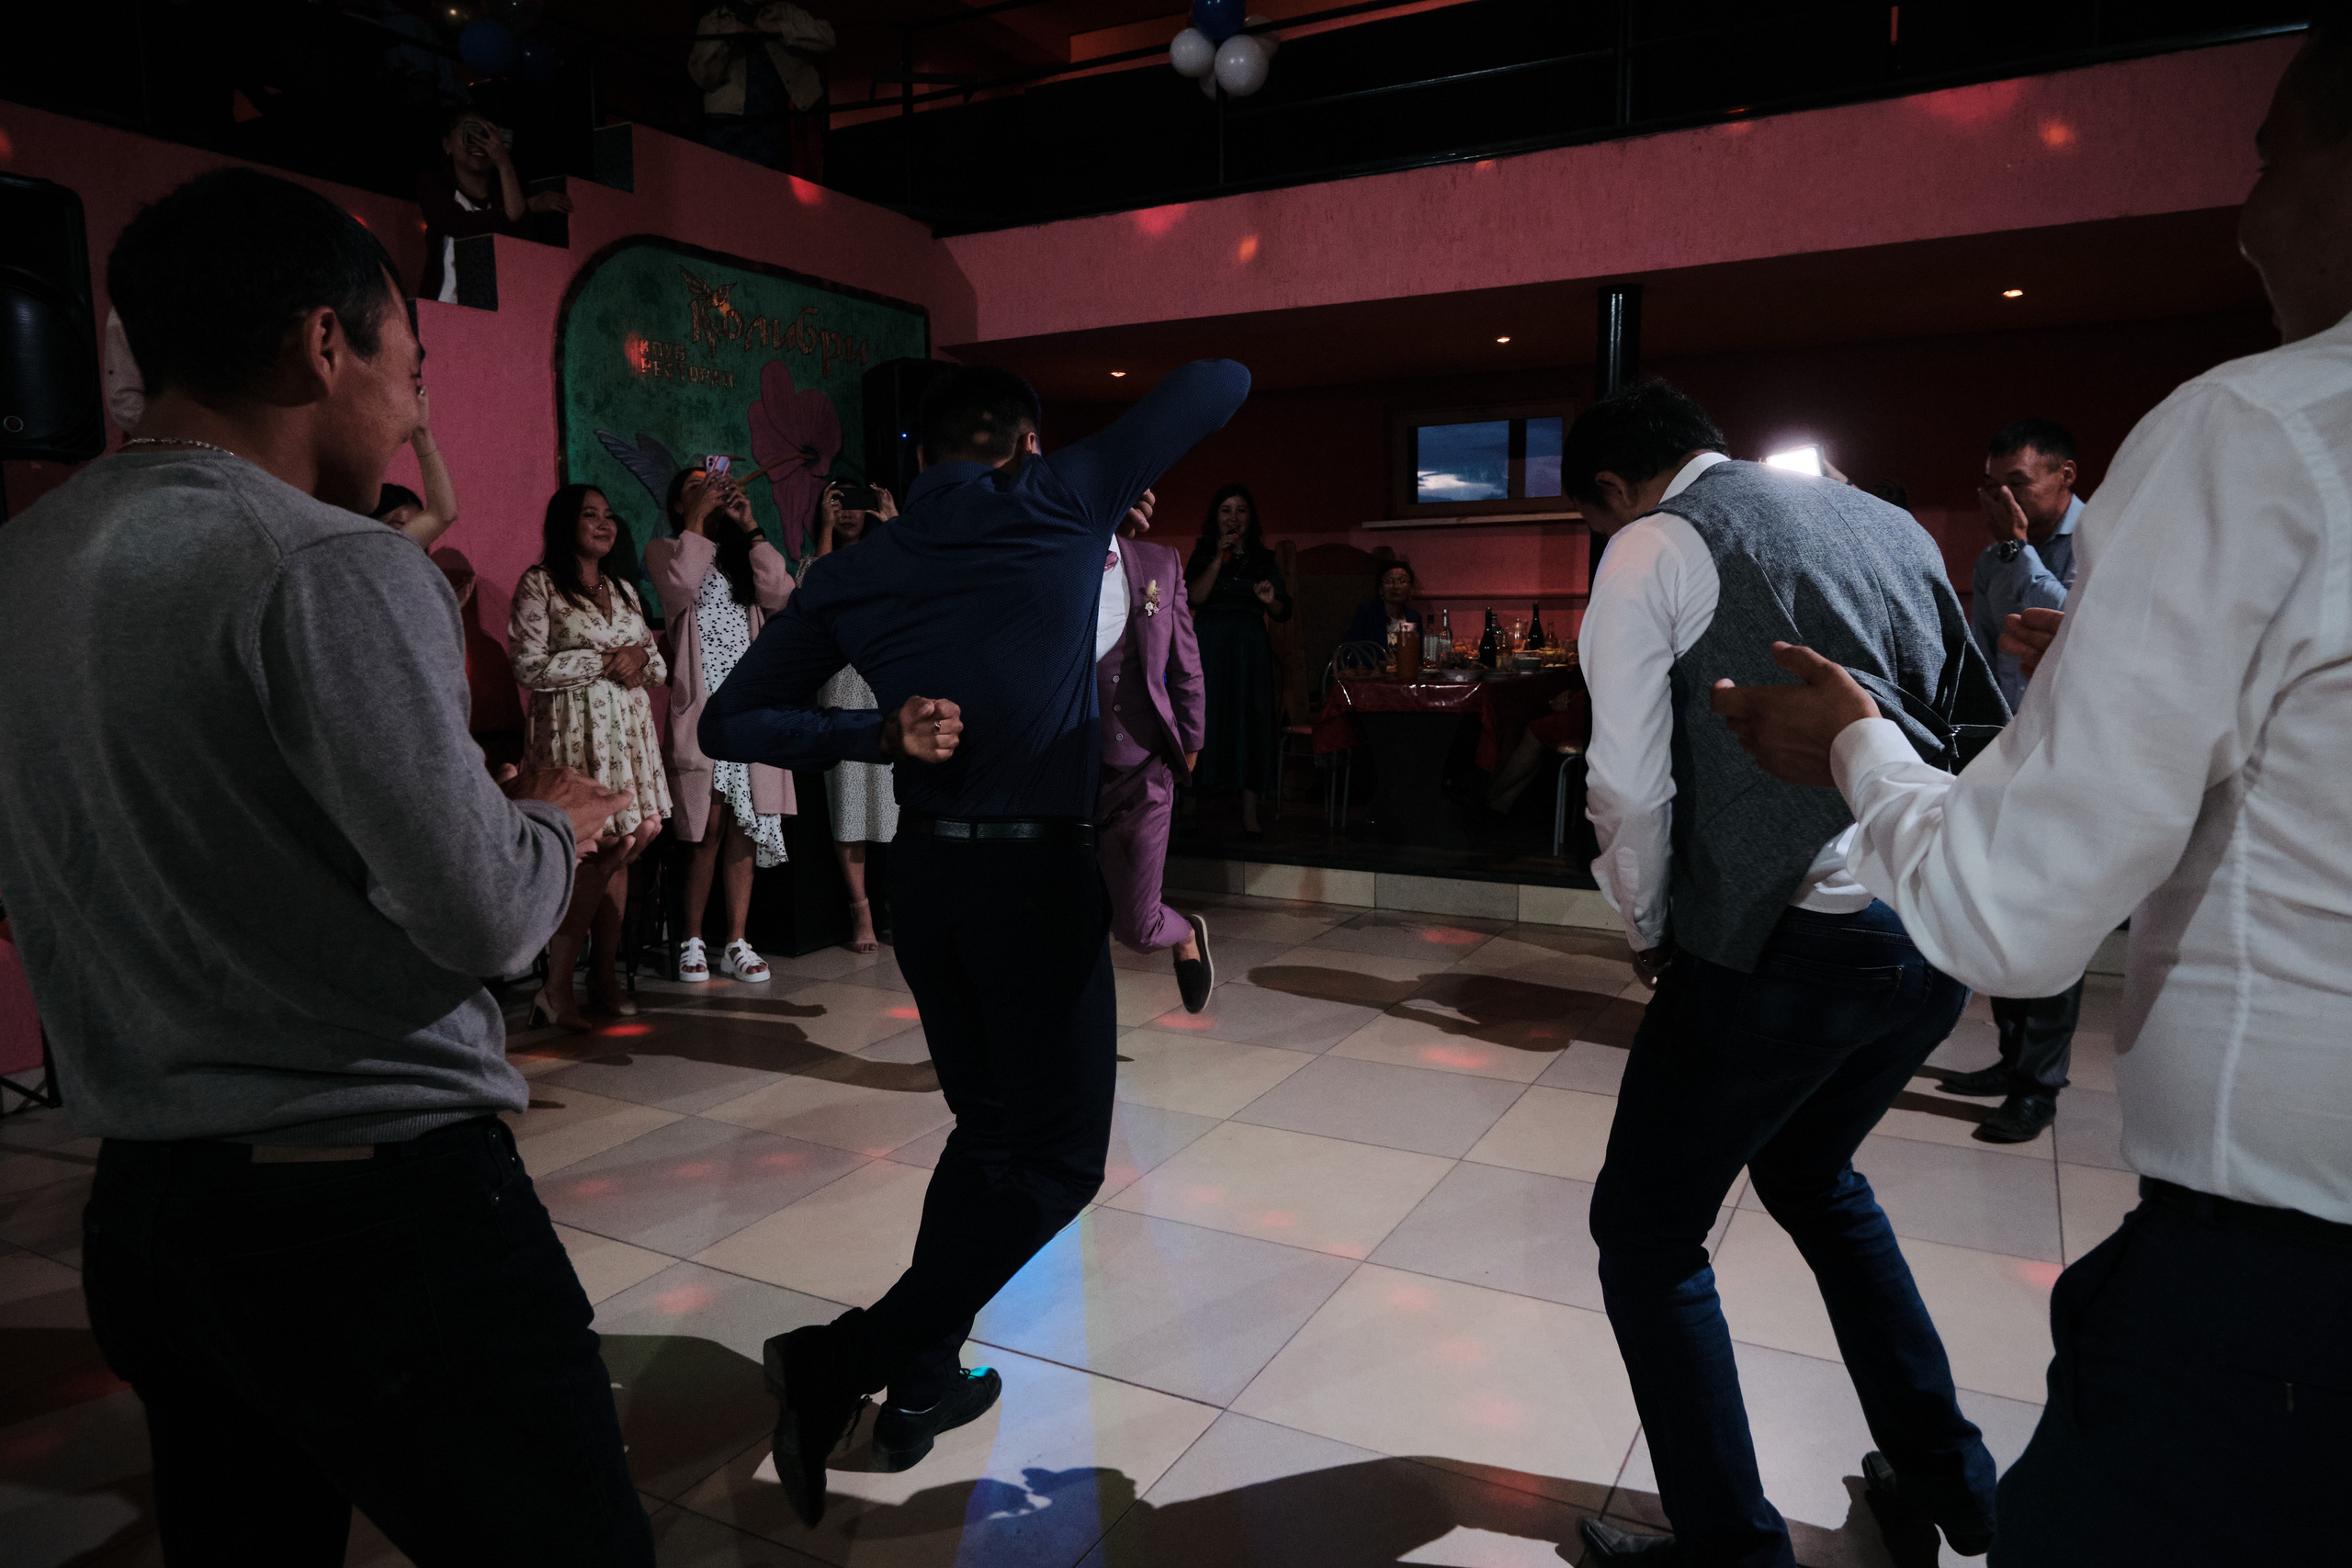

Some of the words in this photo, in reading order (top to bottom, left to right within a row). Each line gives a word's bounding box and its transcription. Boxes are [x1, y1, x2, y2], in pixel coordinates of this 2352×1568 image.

[639, 338, 686, 362] КЛУБ
[690, 298, 868, 378] Колибри
[640, 357, 734, 388] РЕСТОРАН
